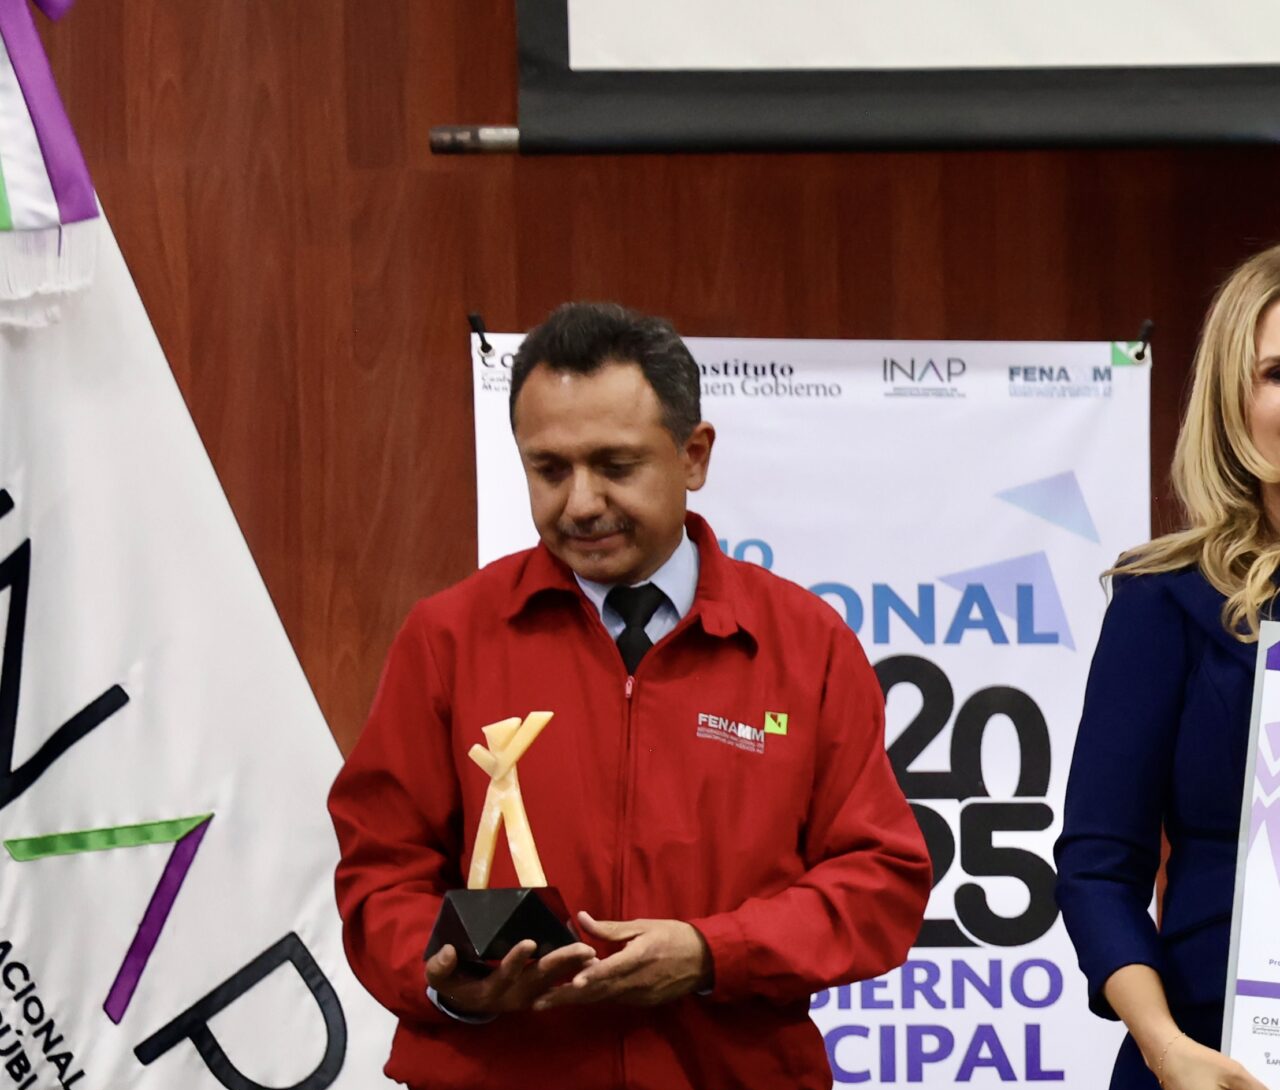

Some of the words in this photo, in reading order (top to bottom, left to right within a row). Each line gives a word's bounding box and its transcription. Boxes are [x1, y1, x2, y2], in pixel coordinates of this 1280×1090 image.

[741, 378, 842, 397] Gobierno
[883, 357, 966, 382] INAP
[806, 582, 1060, 645] ONAL
[871, 654, 1052, 801] 20
[827, 1024, 1065, 1085] CIPAL
